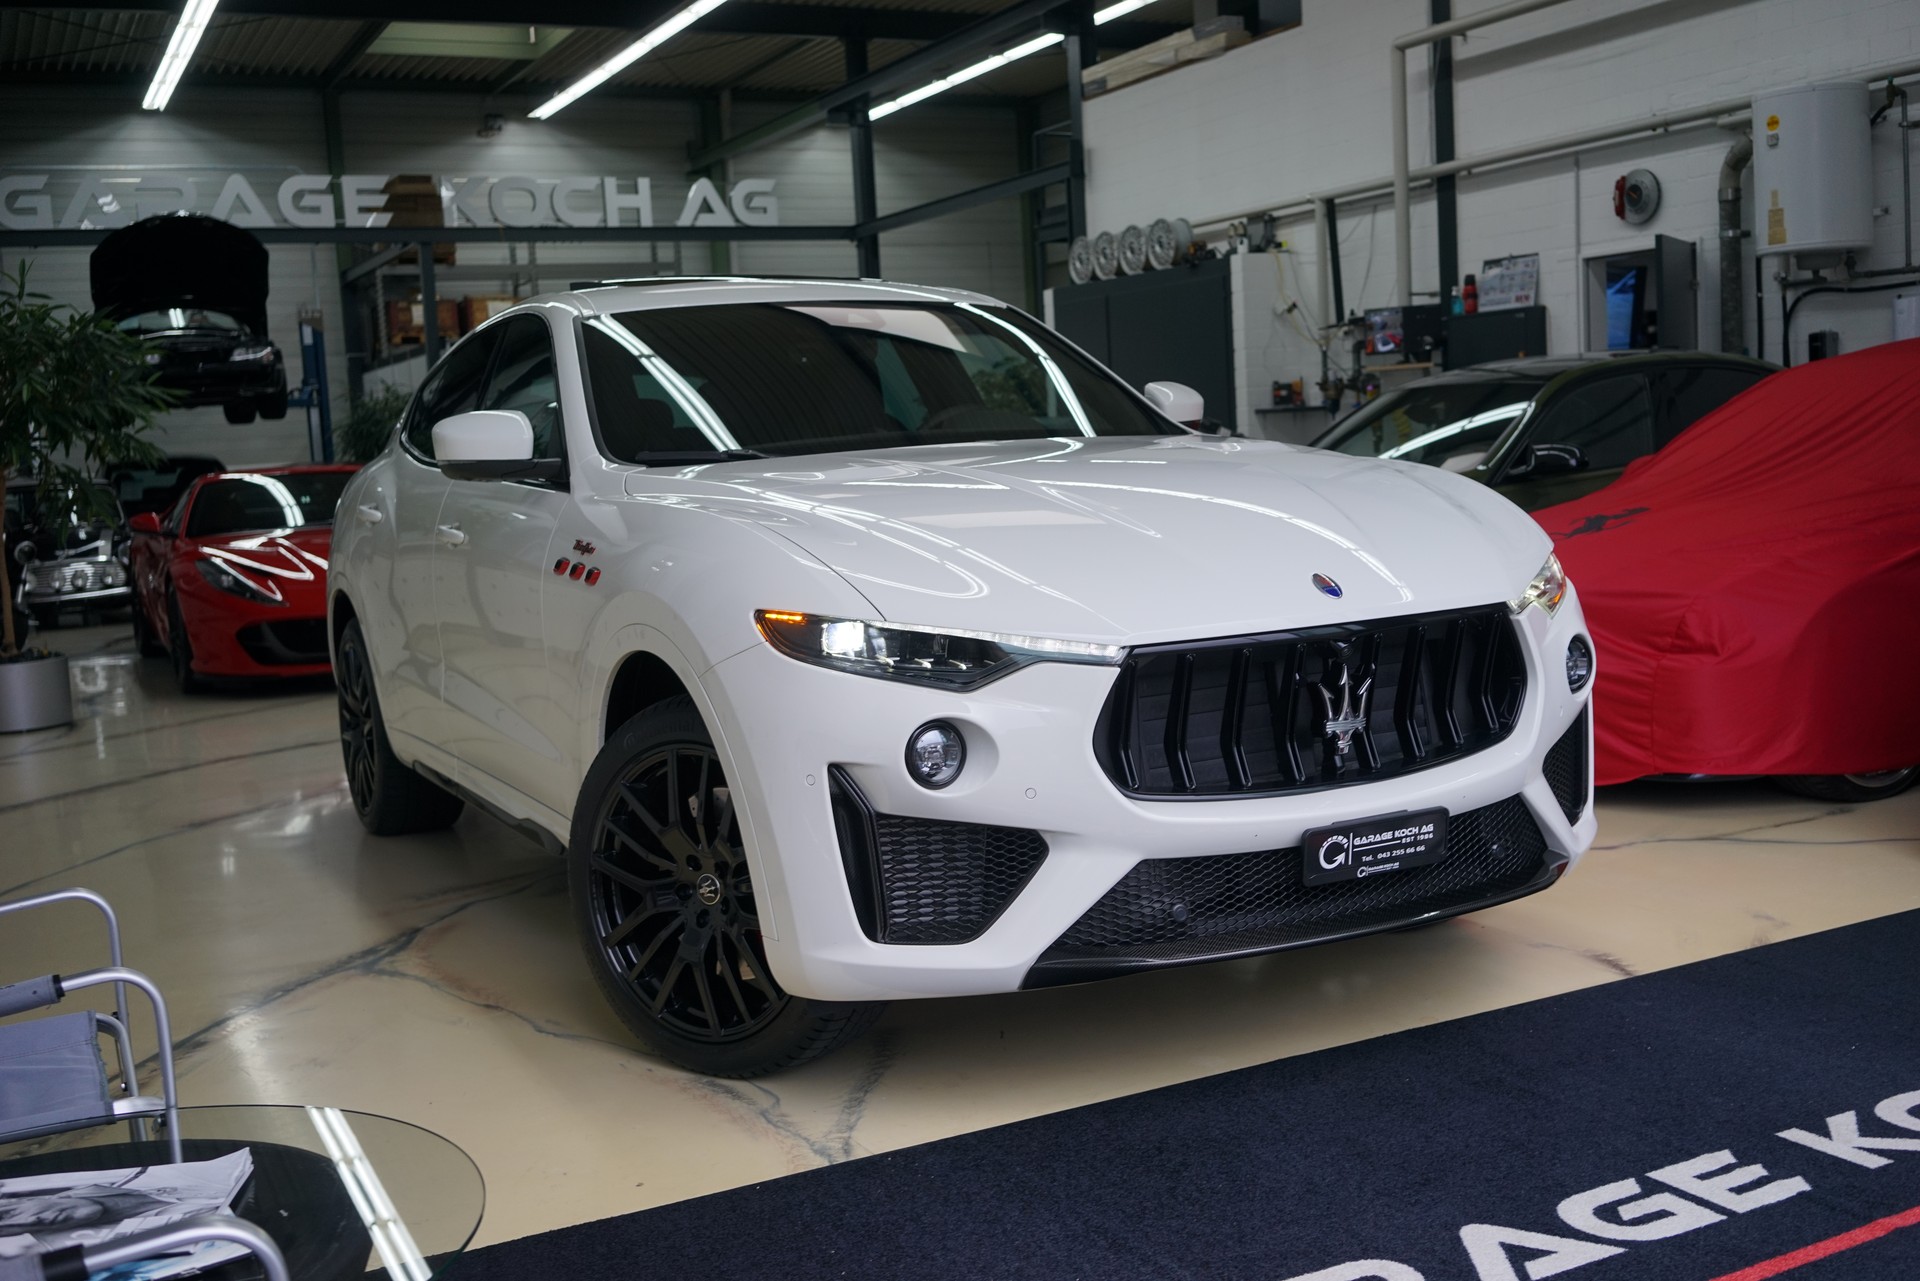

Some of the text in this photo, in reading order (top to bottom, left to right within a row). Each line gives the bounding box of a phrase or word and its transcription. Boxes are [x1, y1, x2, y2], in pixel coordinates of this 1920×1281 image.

[0, 174, 779, 230] GARAGE KOCH AG
[1353, 823, 1434, 845] GARAGE KOCH AG
[1401, 836, 1415, 844] EST
[1377, 851, 1391, 859] 043
[1391, 848, 1405, 857] 255
[1406, 846, 1416, 854] 66
[1416, 844, 1426, 852] 66
